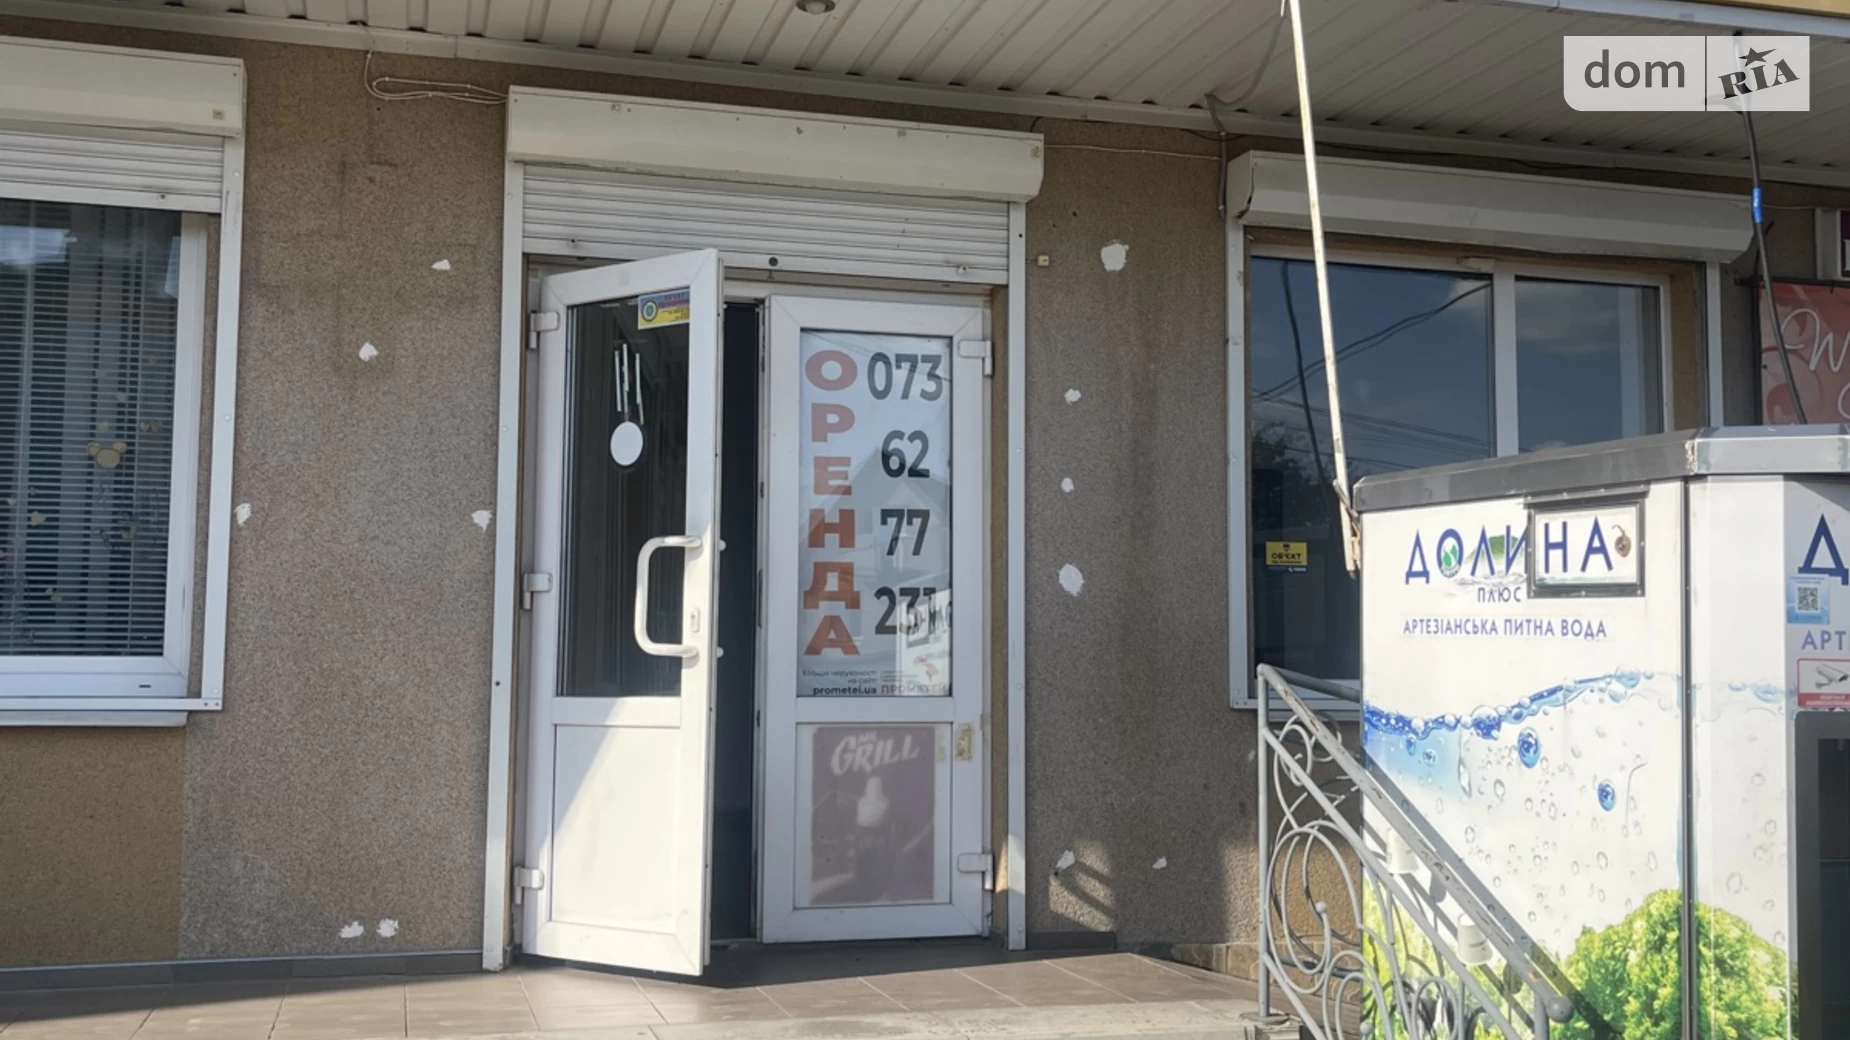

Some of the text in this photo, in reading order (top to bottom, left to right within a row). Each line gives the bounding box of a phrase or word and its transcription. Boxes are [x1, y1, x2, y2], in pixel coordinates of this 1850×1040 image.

[867, 351, 943, 401] 073
[881, 430, 930, 478] 62
[803, 350, 861, 655] ОРЕНДА
[880, 509, 930, 556] 77
[1405, 515, 1614, 585] ДОЛИНА
[1477, 586, 1521, 603] ПЛЮС
[1403, 618, 1607, 640] АРТЕЗІАНСЬКА ПИТНА ВОДА
[813, 685, 877, 696] prometei.ua
[831, 734, 920, 776] GRILL
